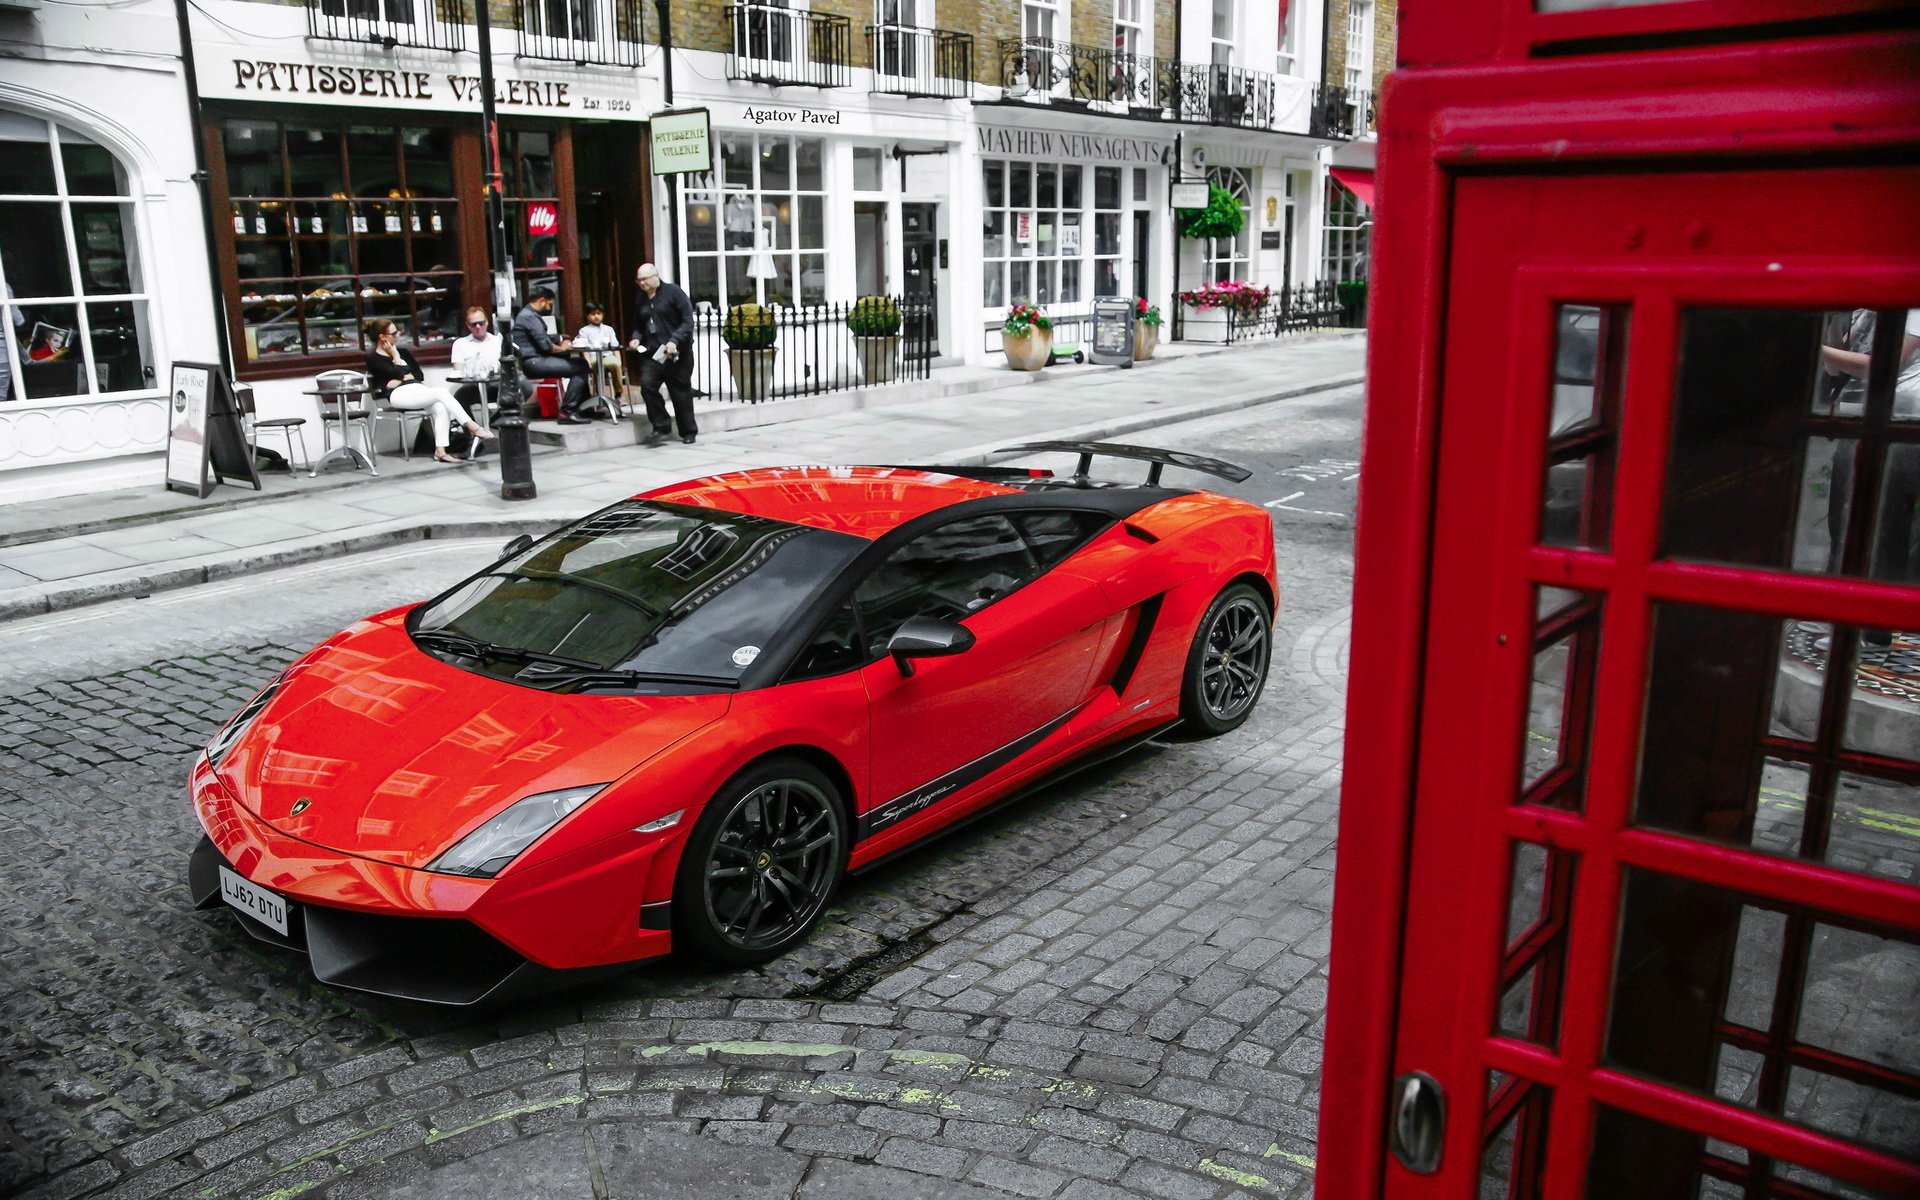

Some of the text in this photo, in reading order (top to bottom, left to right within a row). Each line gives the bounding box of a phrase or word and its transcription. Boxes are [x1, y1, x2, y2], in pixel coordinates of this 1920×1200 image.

[232, 59, 571, 107] PATISSERIE VALERIE
[607, 99, 632, 112] 1926
[655, 128, 705, 143] PATISSERIE
[978, 127, 1160, 163] MAYHEW NEWSAGENTS
[662, 144, 700, 157] VALERIE
[530, 207, 555, 231] illy
[224, 876, 283, 924] LJ62 DTU
